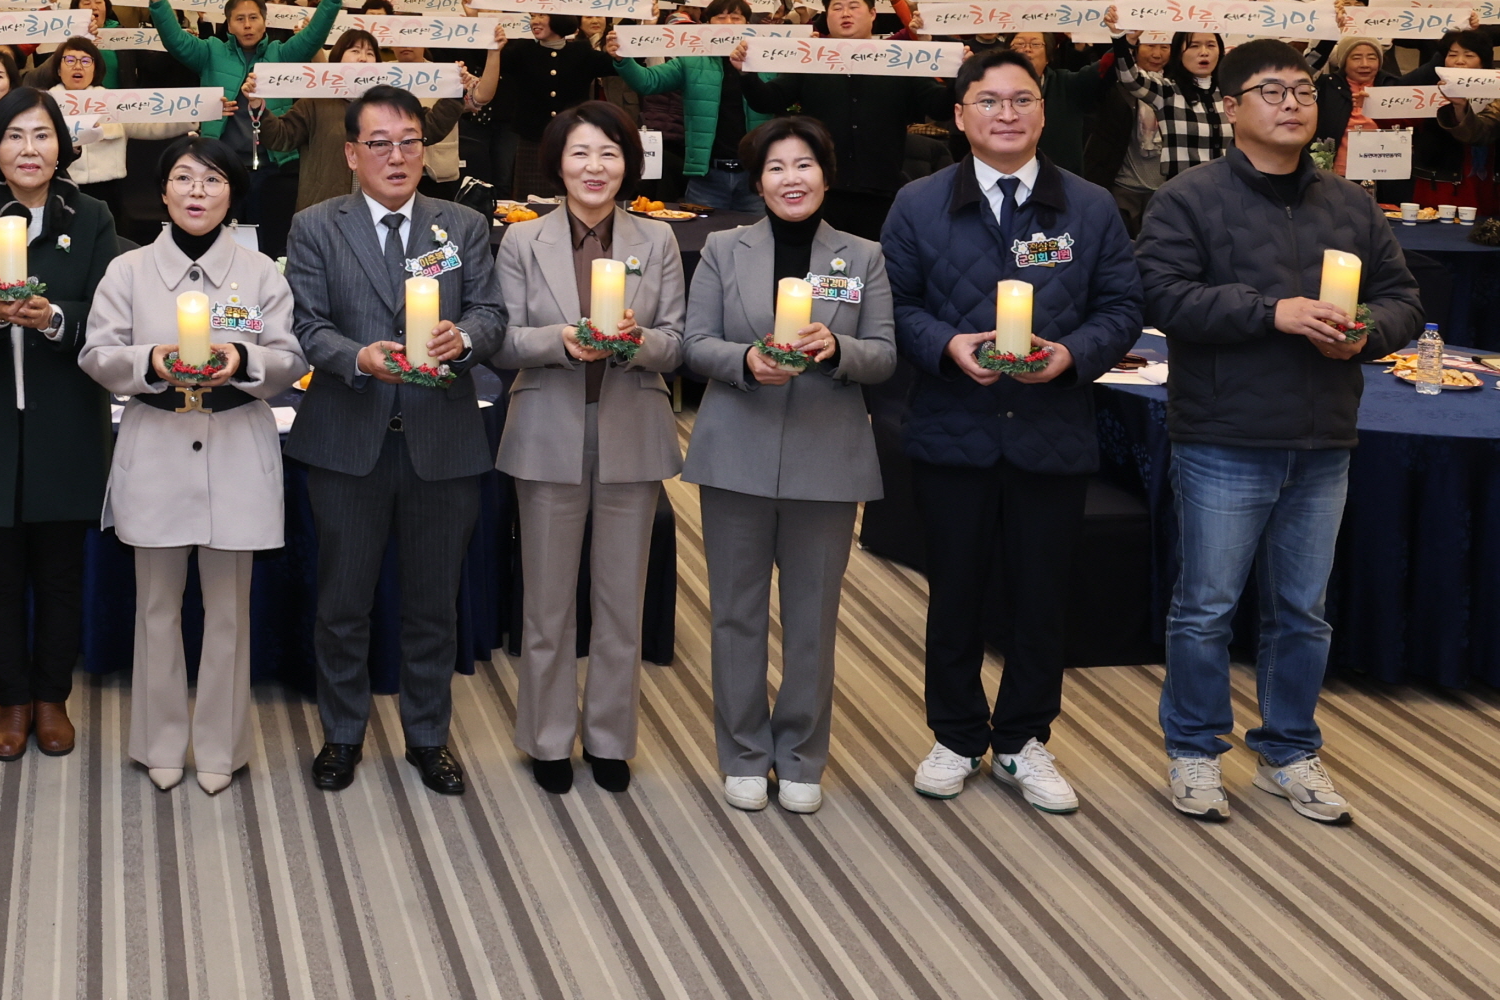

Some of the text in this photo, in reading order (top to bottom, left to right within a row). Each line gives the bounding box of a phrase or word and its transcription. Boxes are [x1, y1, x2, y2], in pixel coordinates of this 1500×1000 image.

[24, 14, 75, 37] 희망
[935, 5, 1057, 30] 당신의 하루, 세상의
[1130, 0, 1320, 32] 당신의 하루, 세상의 희망
[1364, 10, 1456, 34] 세상의 희망
[429, 20, 480, 43] 희망
[631, 28, 743, 53] 당신의 하루, 세상의
[762, 41, 944, 71] 당신의 하루, 세상의 희망
[268, 66, 442, 95] 당신의 하루, 세상의 희망
[1457, 77, 1496, 88] 당신의
[116, 93, 203, 117] 세상의 희망
[1381, 97, 1412, 108] 당신의
[441, 256, 459, 270] 의원
[1017, 249, 1071, 266] 군의회 의원
[840, 289, 860, 301] 의원
[212, 316, 263, 331] 군의회 부의장
